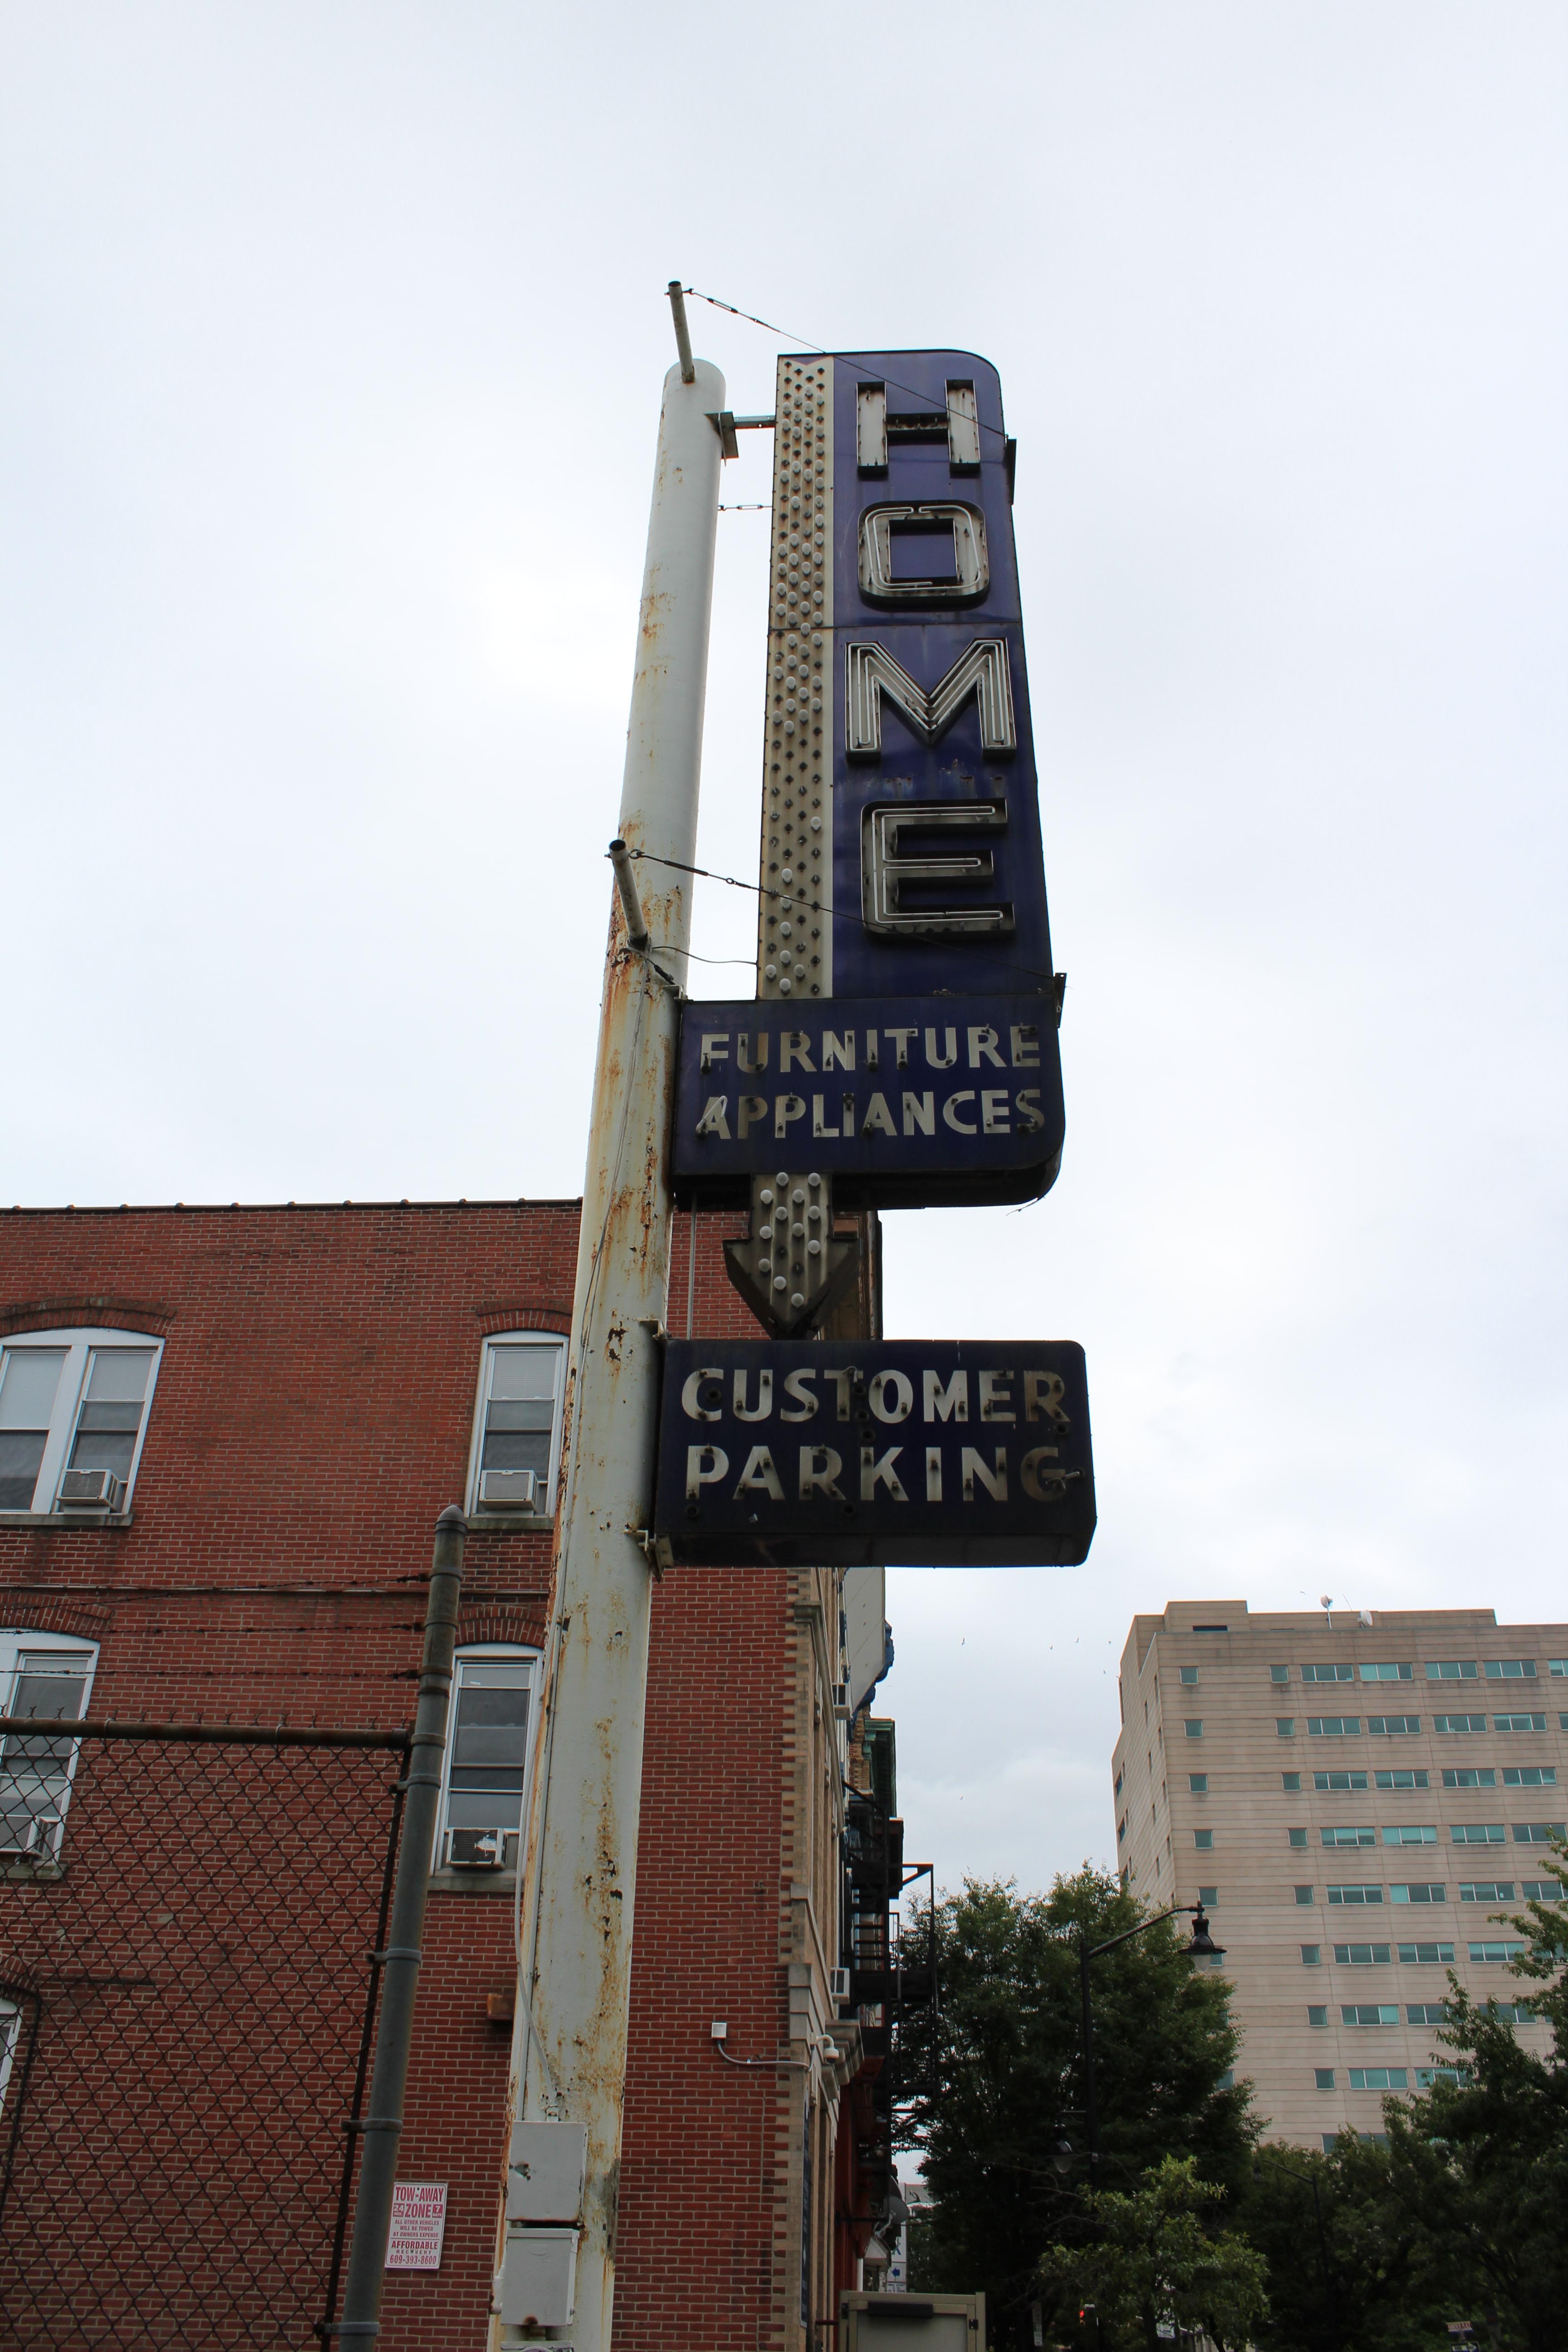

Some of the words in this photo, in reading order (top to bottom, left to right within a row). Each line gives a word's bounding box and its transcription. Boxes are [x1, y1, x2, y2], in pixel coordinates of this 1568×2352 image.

[844, 379, 1016, 940] HOME
[700, 1025, 1041, 1073] FURNITURE
[697, 1089, 1045, 1140] APPLIANCES
[681, 1368, 1071, 1424] CUSTOMER
[685, 1445, 1067, 1502] PARKING
[396, 2187, 444, 2201] TOW-AWAY
[405, 2203, 431, 2218] ZONE
[390, 2254, 436, 2264] 609-393-8600
[392, 2240, 438, 2249] AFFORDABLE
